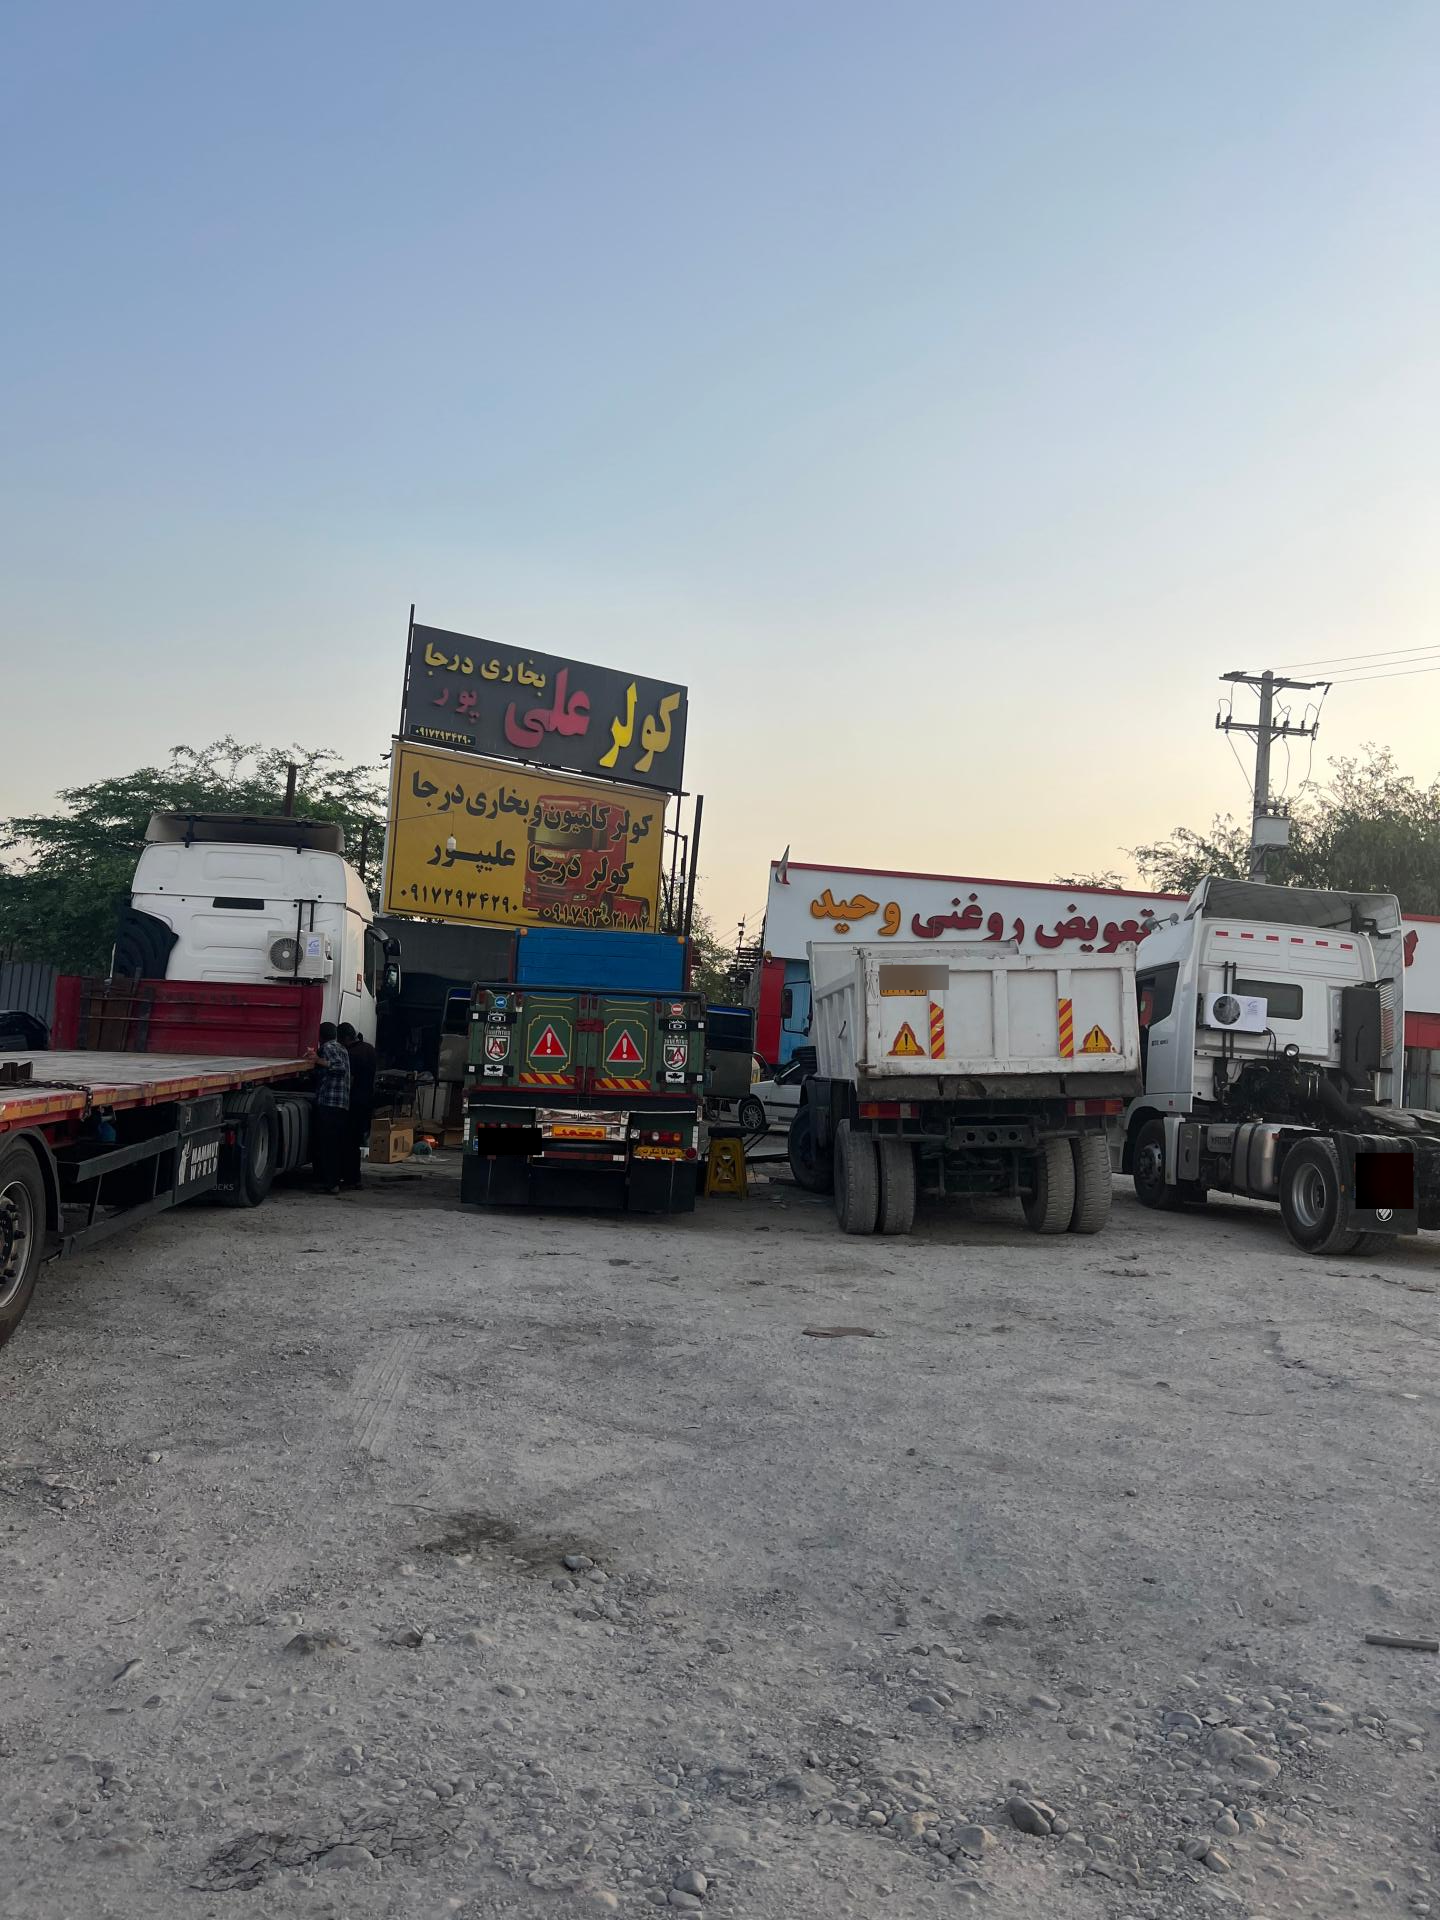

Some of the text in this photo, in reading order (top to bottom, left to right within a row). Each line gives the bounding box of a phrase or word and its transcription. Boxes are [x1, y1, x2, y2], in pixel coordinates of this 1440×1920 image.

[424, 642, 546, 697] بخاری درجا
[433, 667, 681, 773] کولر علی پور
[413, 770, 464, 811] درجا
[466, 786, 530, 824] بخاری
[544, 803, 611, 833] کامیون
[610, 810, 653, 844] کولر
[528, 844, 634, 892] کولر درجا
[400, 883, 518, 914] ۰۹۱۷۲۹۳۴۲۹۰
[810, 888, 902, 937] وحید
[911, 892, 1025, 944] روغنی
[191, 1141, 219, 1164] MAMMUT
